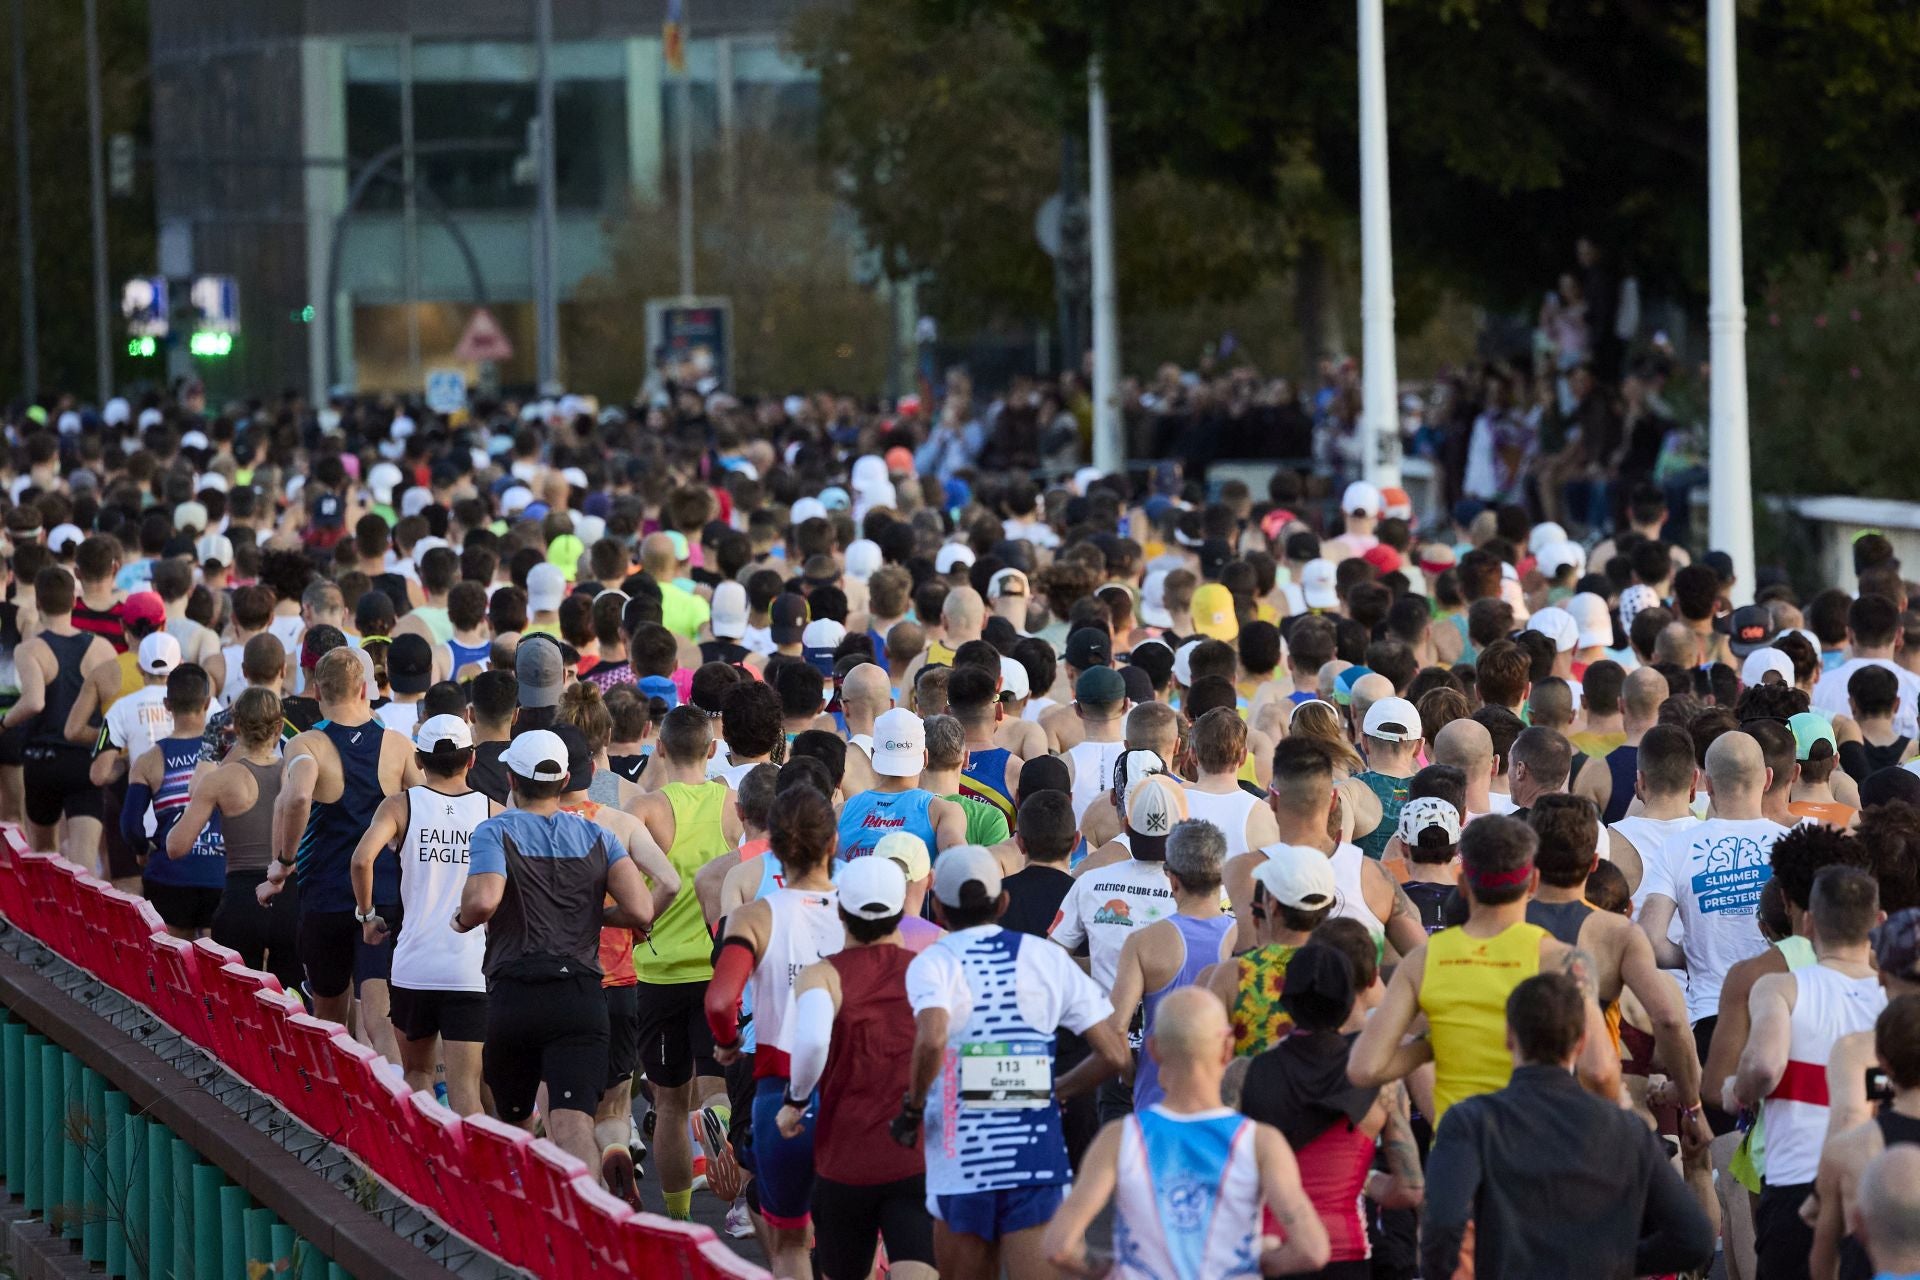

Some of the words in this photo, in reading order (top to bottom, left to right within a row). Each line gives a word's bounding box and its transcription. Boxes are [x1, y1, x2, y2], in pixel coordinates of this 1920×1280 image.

[897, 741, 913, 750] edp
[419, 847, 471, 864] EAGLE
[1705, 869, 1760, 887] SLIMMER
[1093, 882, 1126, 893] ATLÉTICO
[1127, 886, 1152, 897] CLUBE
[1152, 887, 1169, 898] SÃO
[997, 1061, 1020, 1073] 113
